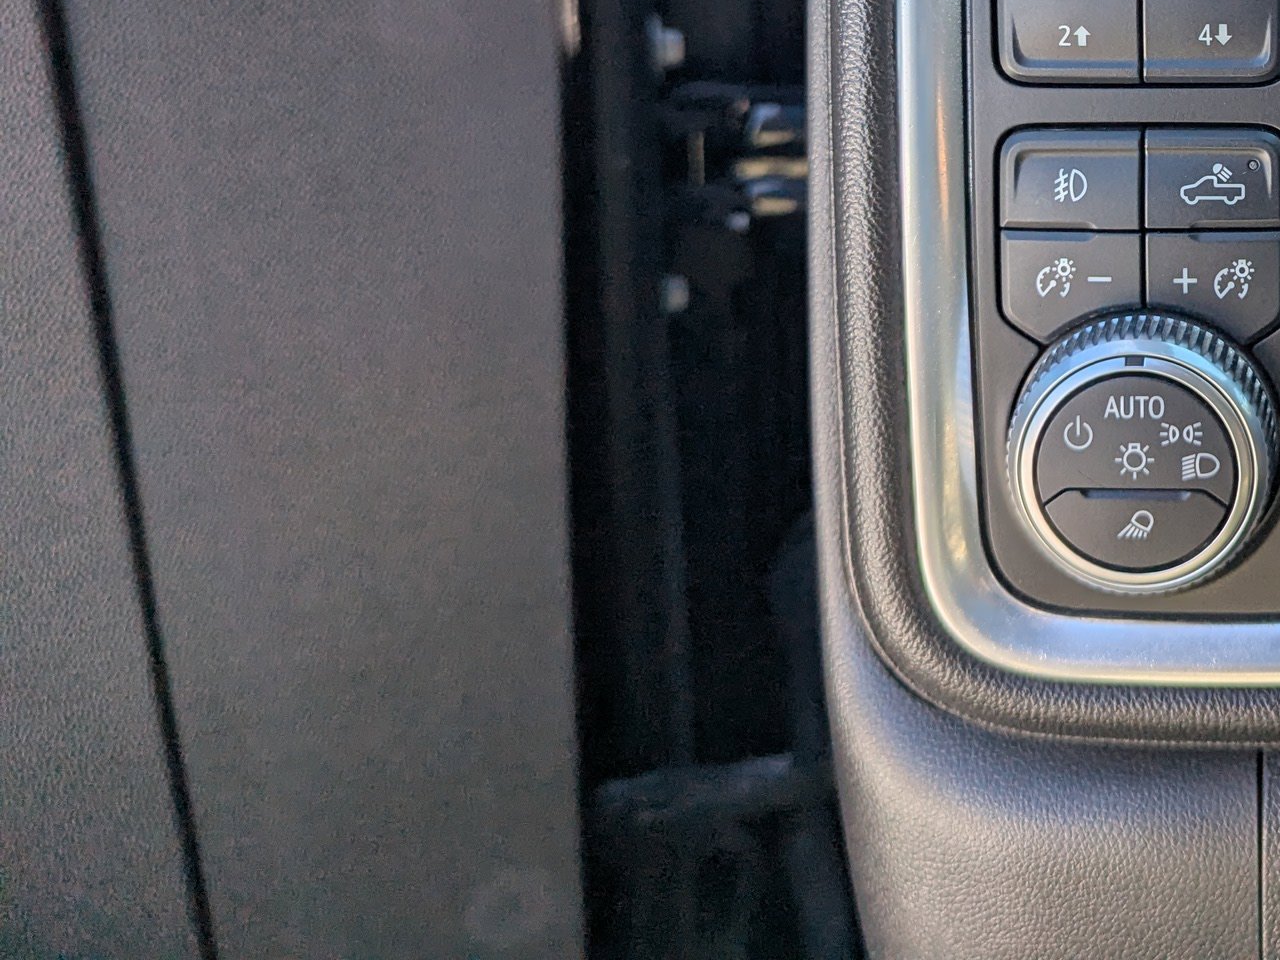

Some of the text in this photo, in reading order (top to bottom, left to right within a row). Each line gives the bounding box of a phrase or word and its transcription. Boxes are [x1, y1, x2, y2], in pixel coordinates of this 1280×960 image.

[1058, 25, 1071, 47] 2
[1198, 24, 1213, 46] 4
[1104, 395, 1165, 419] AUTO
